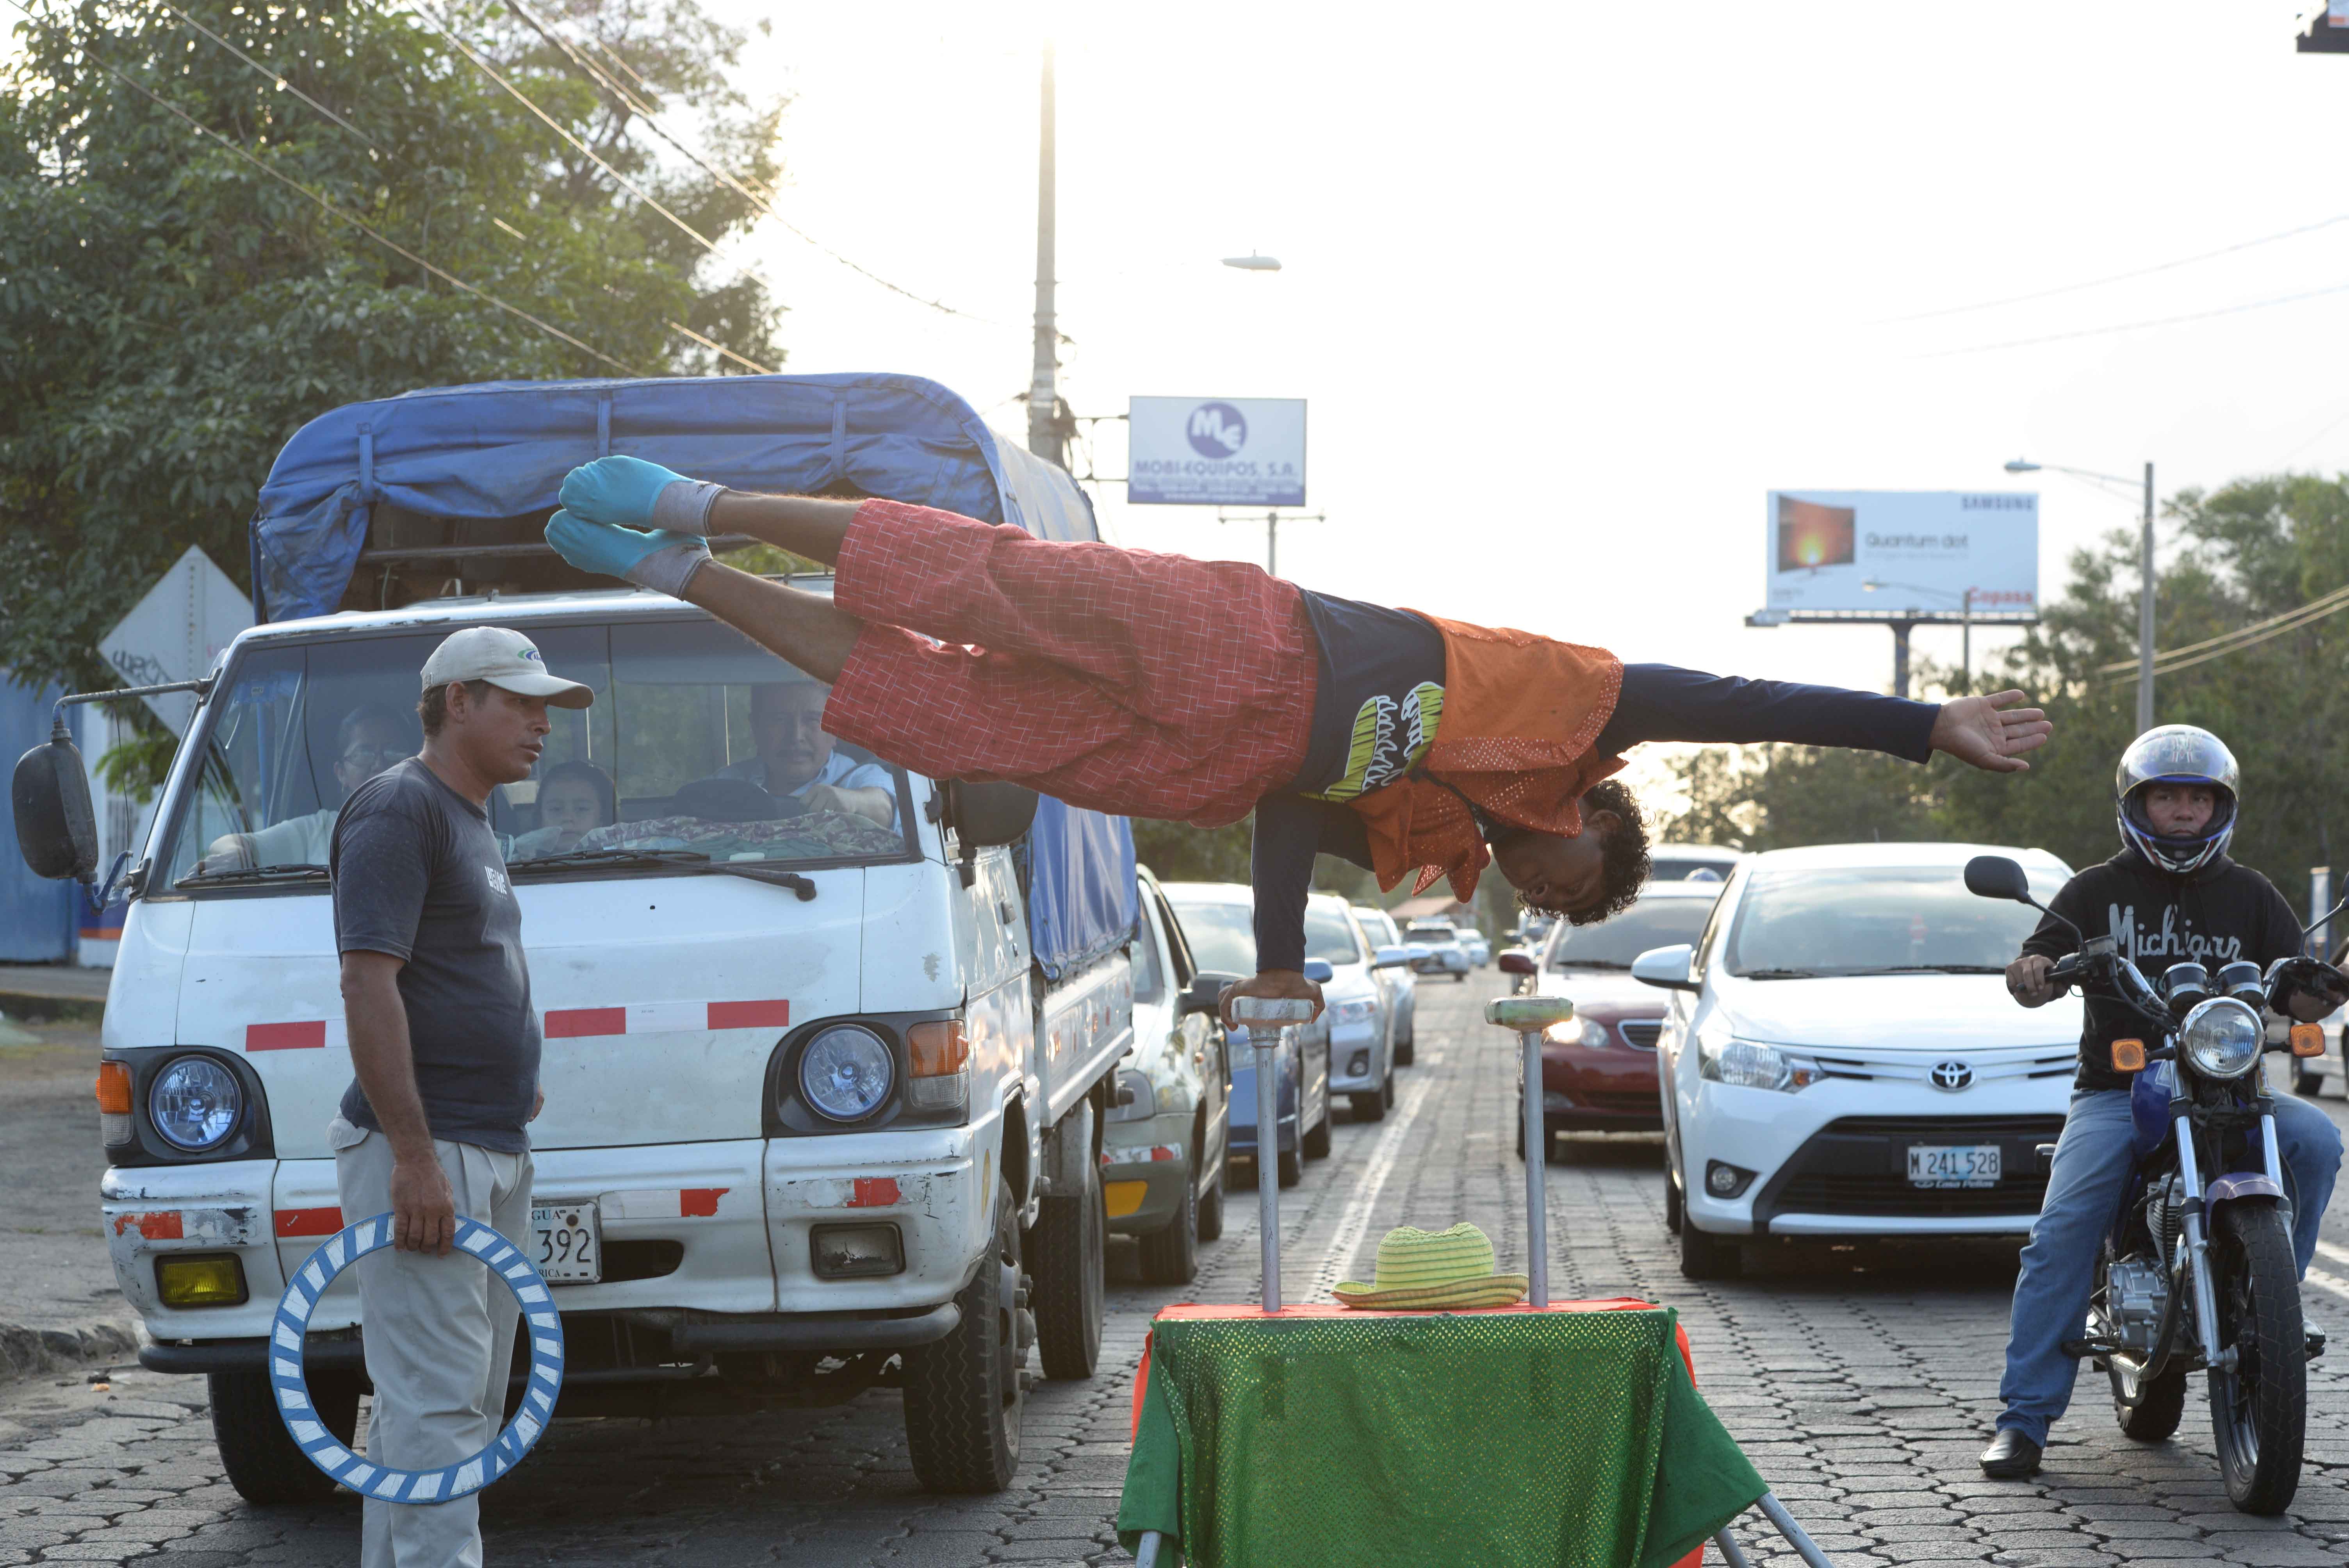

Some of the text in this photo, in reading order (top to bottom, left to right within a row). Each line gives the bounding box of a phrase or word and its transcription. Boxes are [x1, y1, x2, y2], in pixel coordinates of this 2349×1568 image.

[1961, 495, 2034, 511] SAMSUNG
[1865, 532, 1969, 549] Quantum dot
[1927, 1153, 1958, 1174] 241
[1966, 1153, 1998, 1174] 528
[531, 1210, 561, 1221] GUA
[537, 1228, 591, 1263] 392
[538, 1268, 560, 1278] RICA
